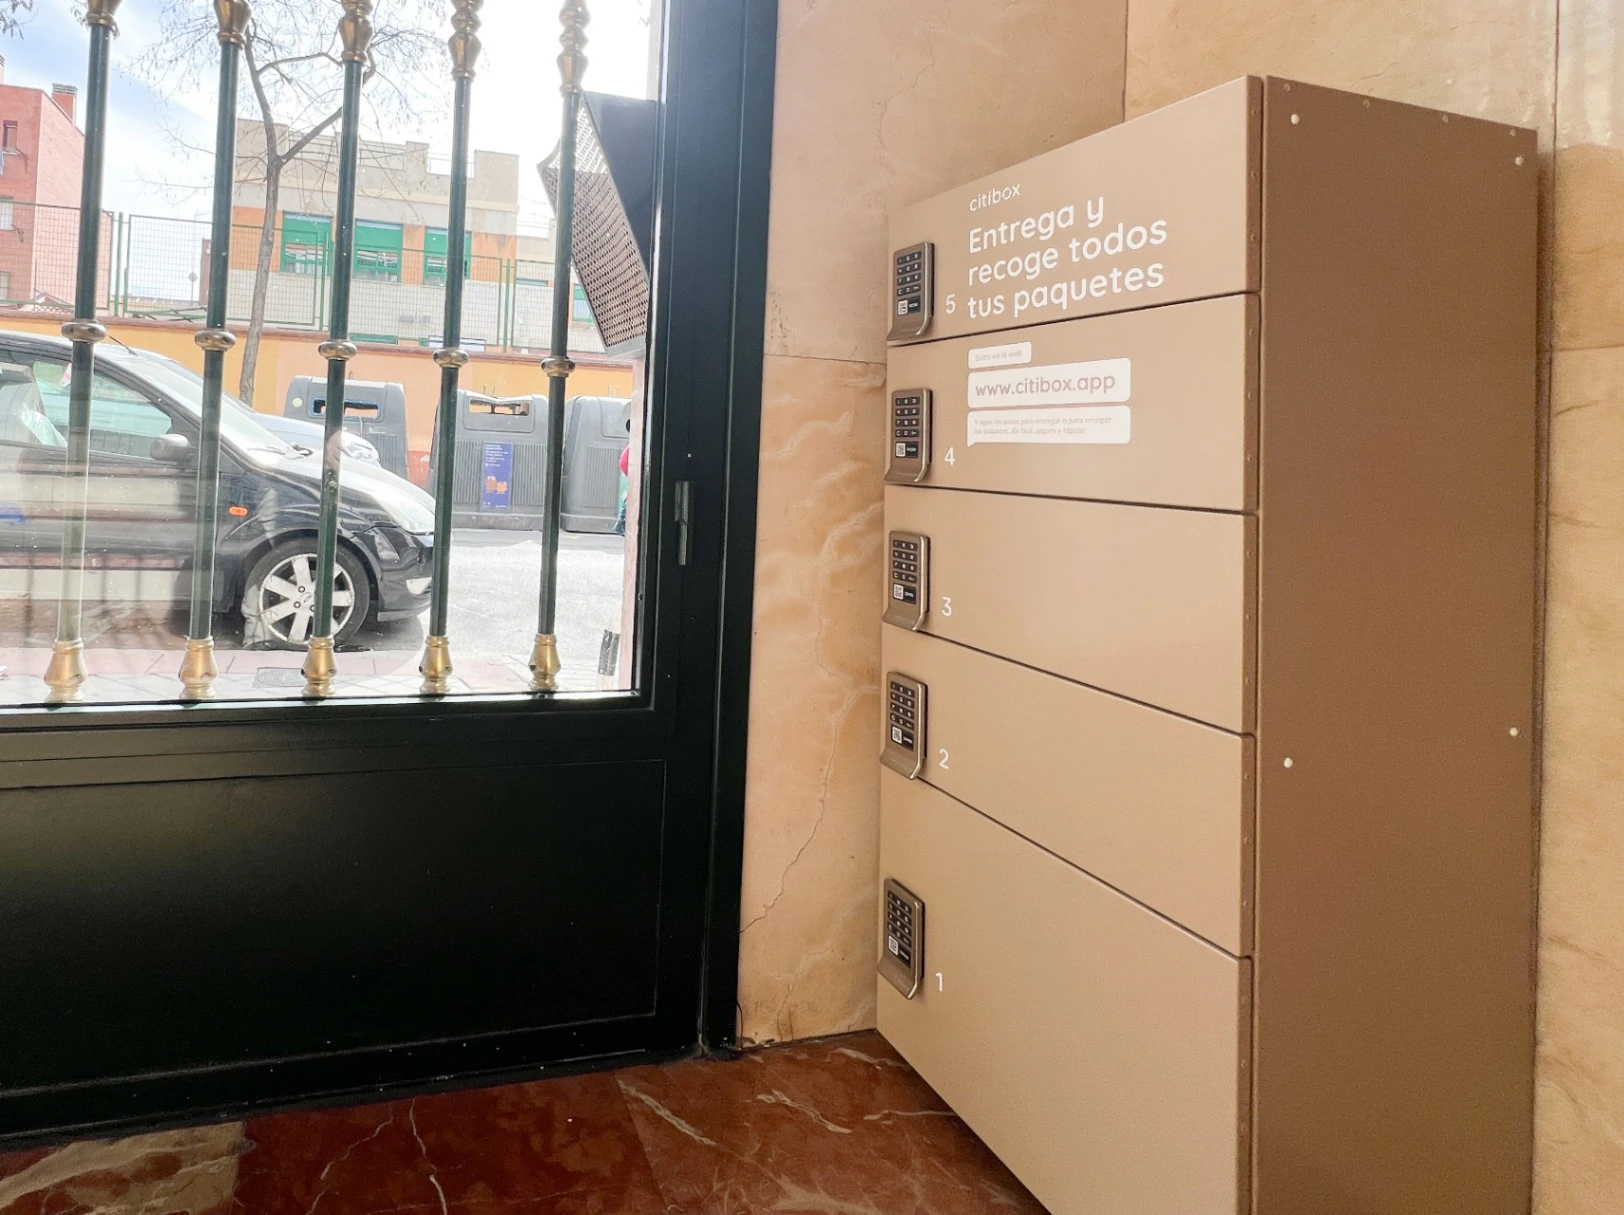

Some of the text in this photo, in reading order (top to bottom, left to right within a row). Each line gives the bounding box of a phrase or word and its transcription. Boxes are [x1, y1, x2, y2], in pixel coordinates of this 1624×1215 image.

[969, 183, 1021, 211] citibox
[969, 196, 1104, 254] Entrega y
[968, 247, 1059, 286] recoge
[1069, 219, 1167, 263] todos
[967, 262, 1164, 319] tus paquetes
[945, 294, 956, 314] 5
[975, 375, 1116, 397] www.citibox.app
[944, 446, 956, 466] 4
[941, 596, 952, 617] 3
[939, 748, 950, 770] 2
[935, 972, 943, 992] 1
